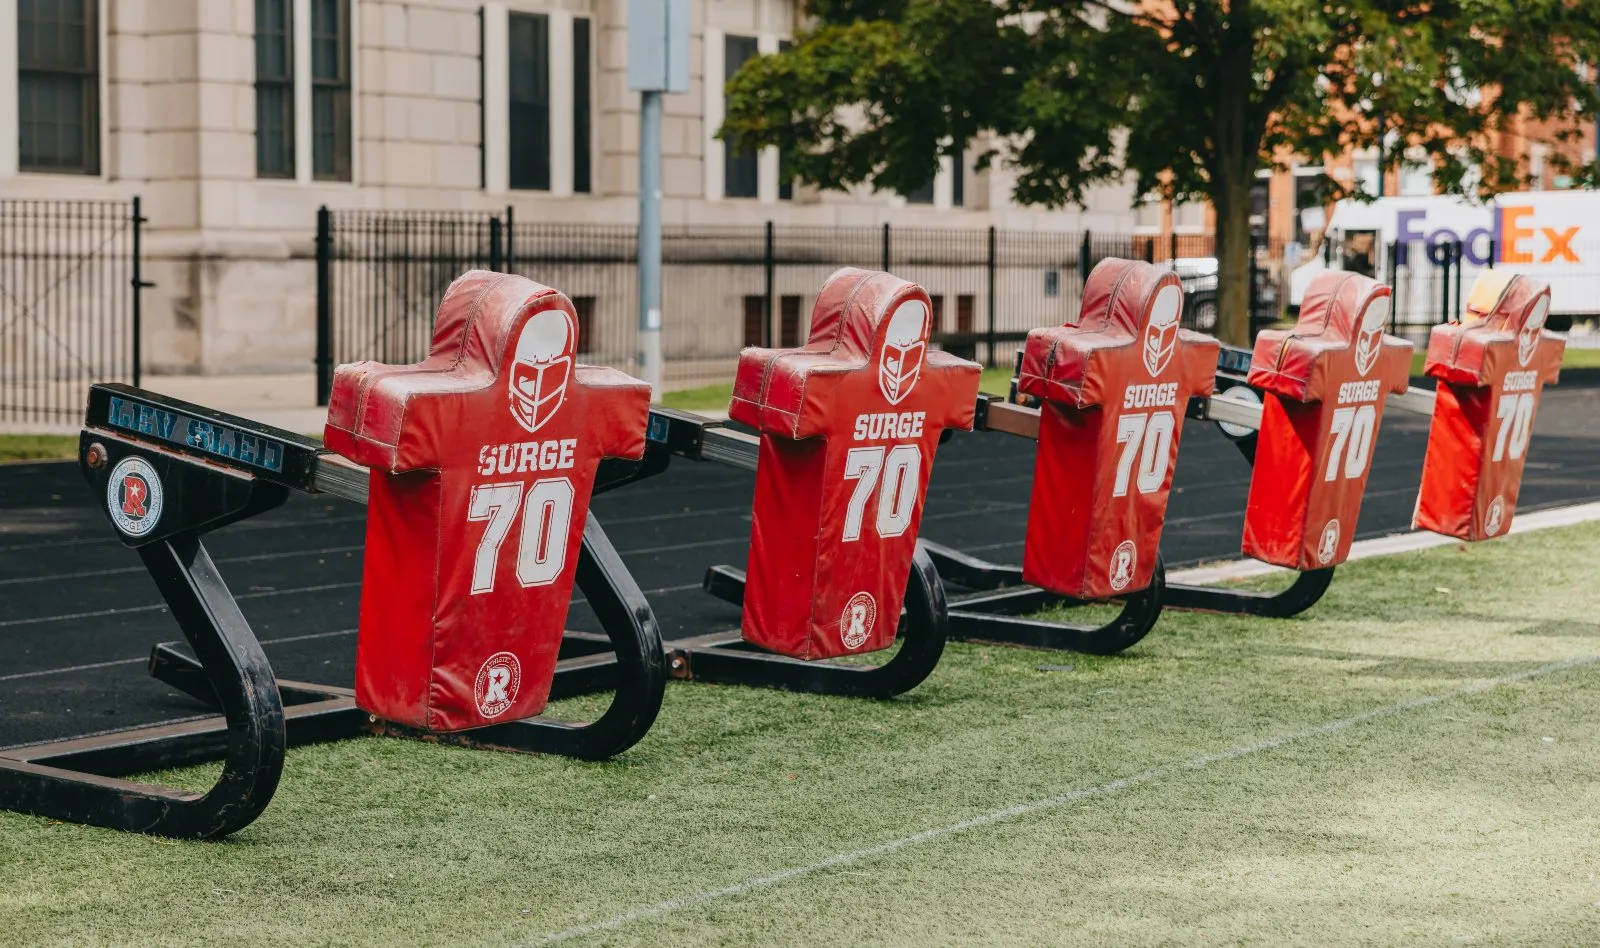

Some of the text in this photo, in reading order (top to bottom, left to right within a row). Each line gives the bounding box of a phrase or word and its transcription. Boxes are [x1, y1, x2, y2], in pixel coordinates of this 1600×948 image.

[1397, 203, 1581, 266] FedEx
[1124, 382, 1178, 409] SURGE
[1338, 380, 1381, 404] SURGE
[1503, 370, 1538, 391] SURGE
[110, 397, 285, 473] LEV SLED
[854, 411, 926, 441] SURGE
[1325, 405, 1376, 482] 70
[1492, 393, 1534, 462] 70
[477, 438, 577, 476] SURGE
[1112, 411, 1175, 498] 70
[842, 444, 922, 543] 70
[119, 515, 151, 531] ROGERS
[466, 476, 575, 596] 70
[485, 666, 511, 703] R
[480, 698, 511, 715] ROGERS
